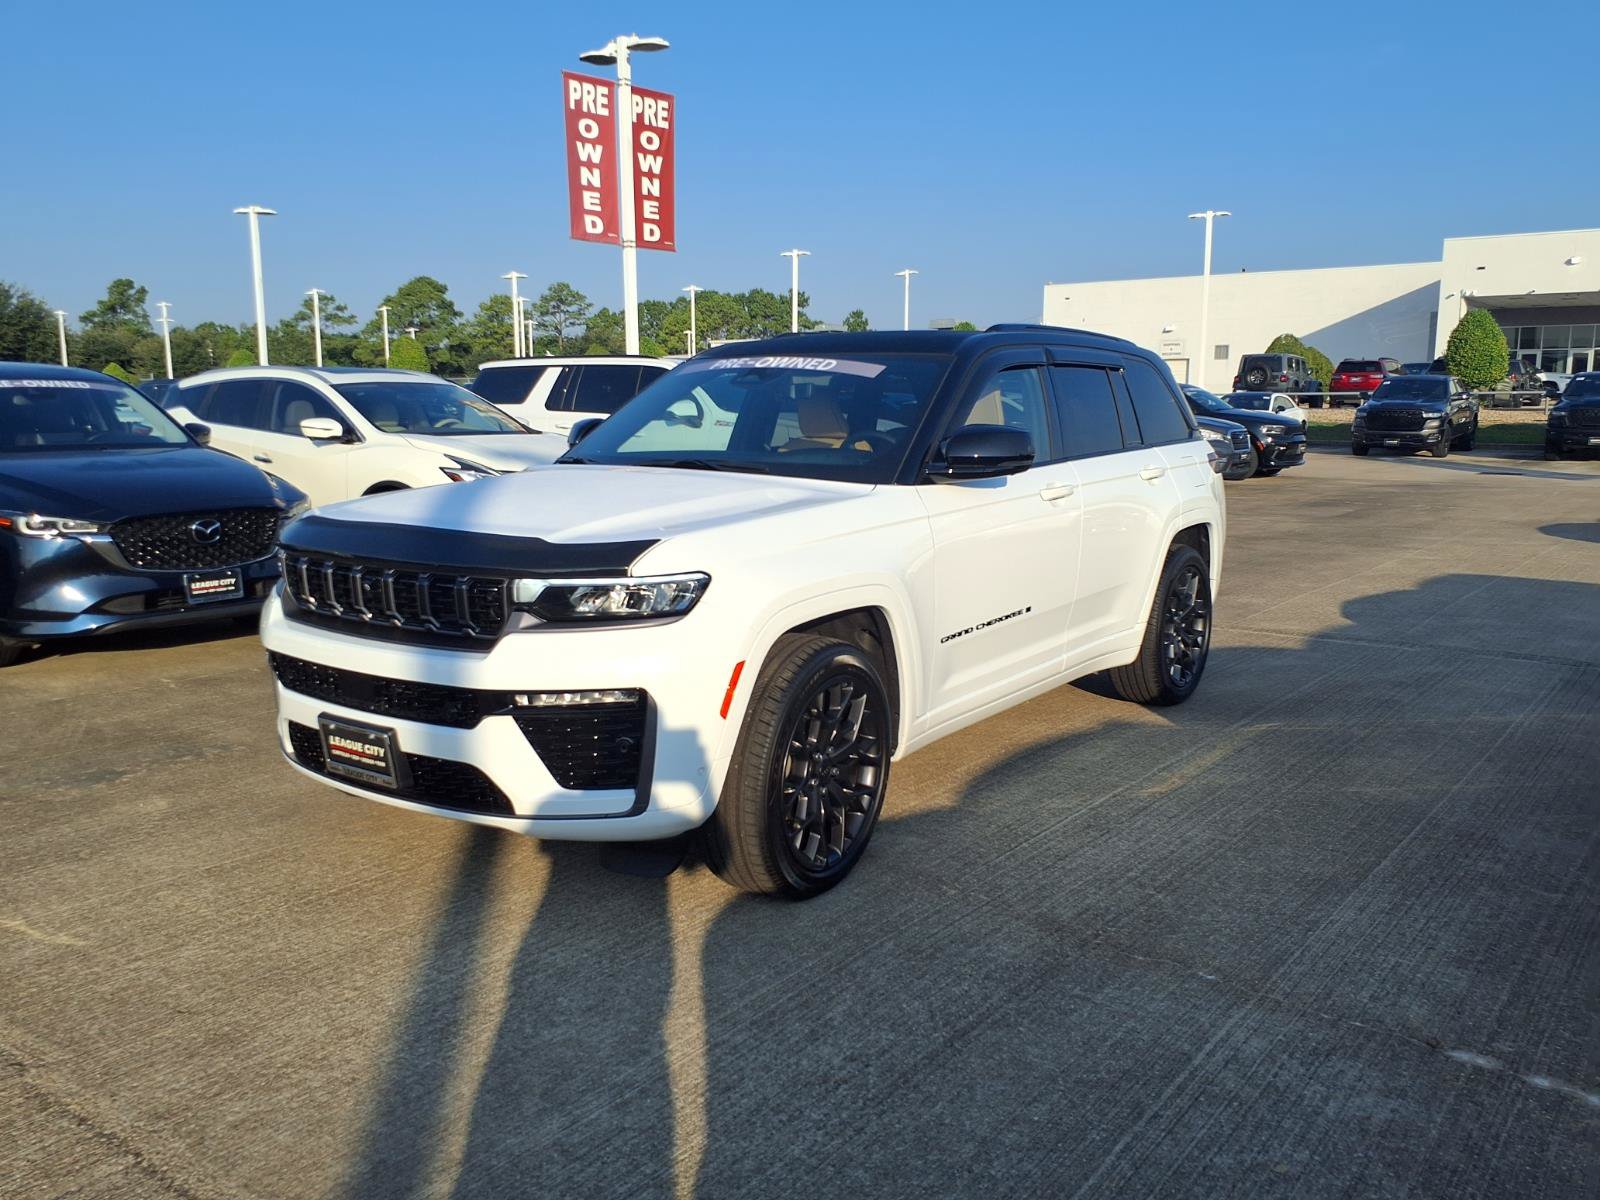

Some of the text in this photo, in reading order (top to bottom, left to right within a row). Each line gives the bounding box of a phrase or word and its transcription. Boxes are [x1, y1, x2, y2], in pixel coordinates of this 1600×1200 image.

[568, 79, 609, 234] PRE OWNED
[631, 93, 669, 242] PRE OWNED
[709, 356, 837, 370] PRE-OWNED
[220, 578, 236, 586] CITY
[941, 608, 1024, 643] GRAND CHEROKEE
[329, 736, 384, 757] LEAGUE CITY
